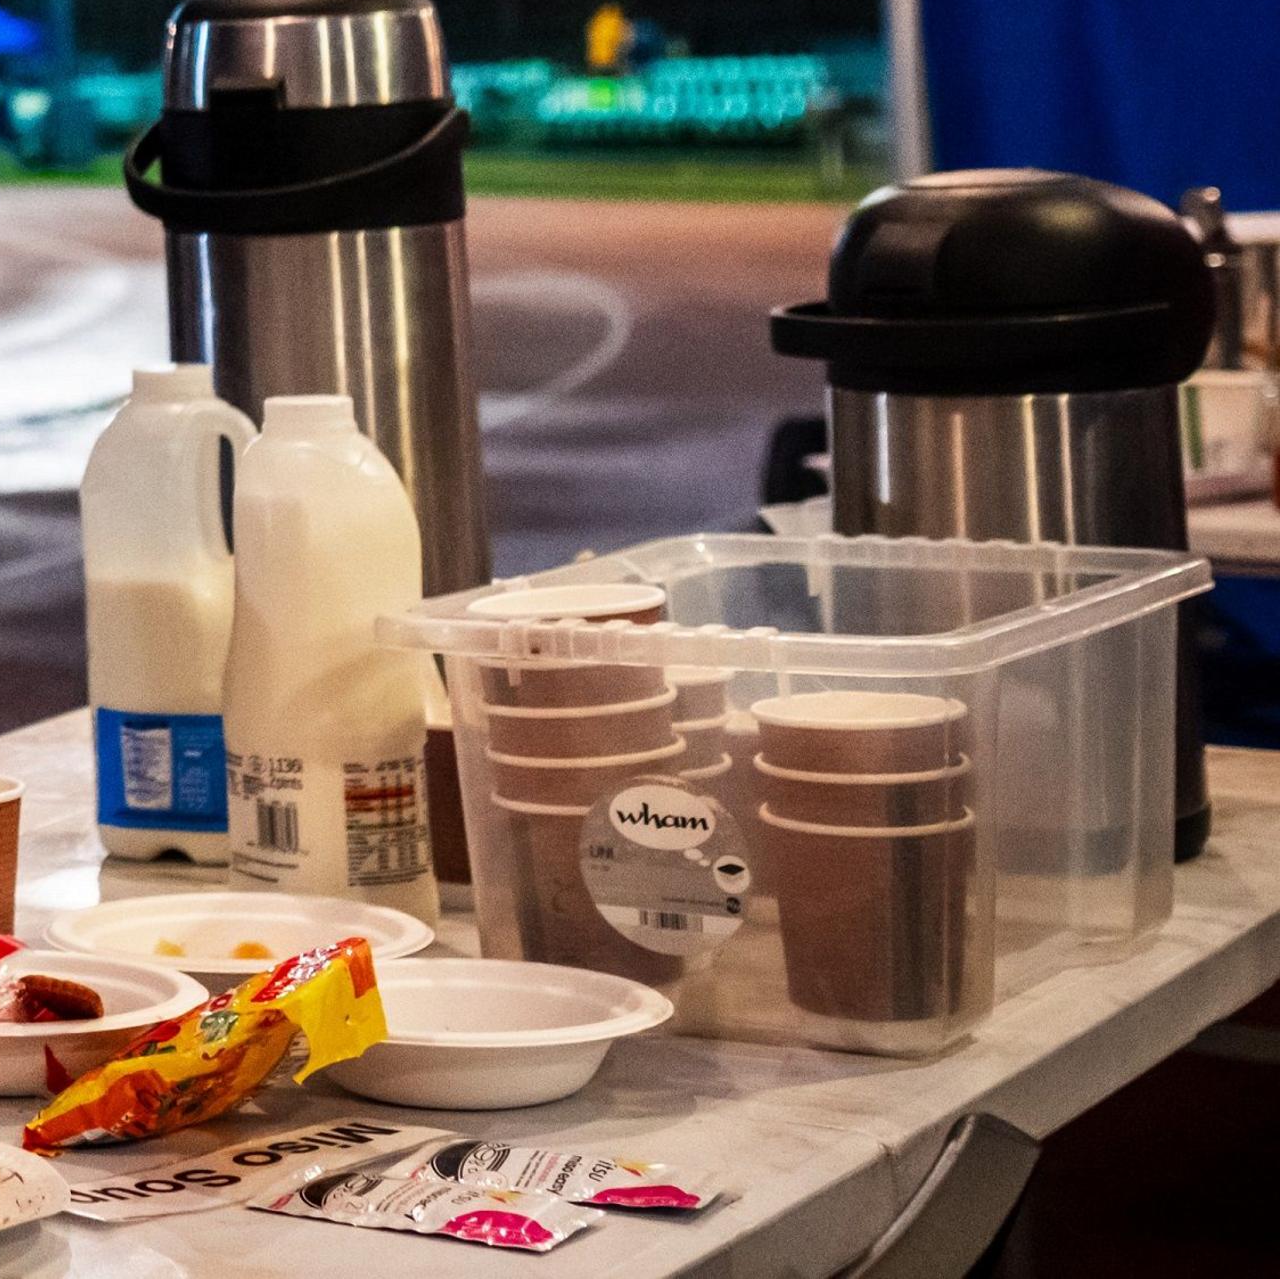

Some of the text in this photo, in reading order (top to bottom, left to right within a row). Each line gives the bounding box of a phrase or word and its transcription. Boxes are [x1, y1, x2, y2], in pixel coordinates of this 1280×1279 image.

[616, 802, 709, 831] wham
[232, 1122, 401, 1167] Miso
[546, 1171, 570, 1196] easy
[588, 1159, 617, 1182] itsu
